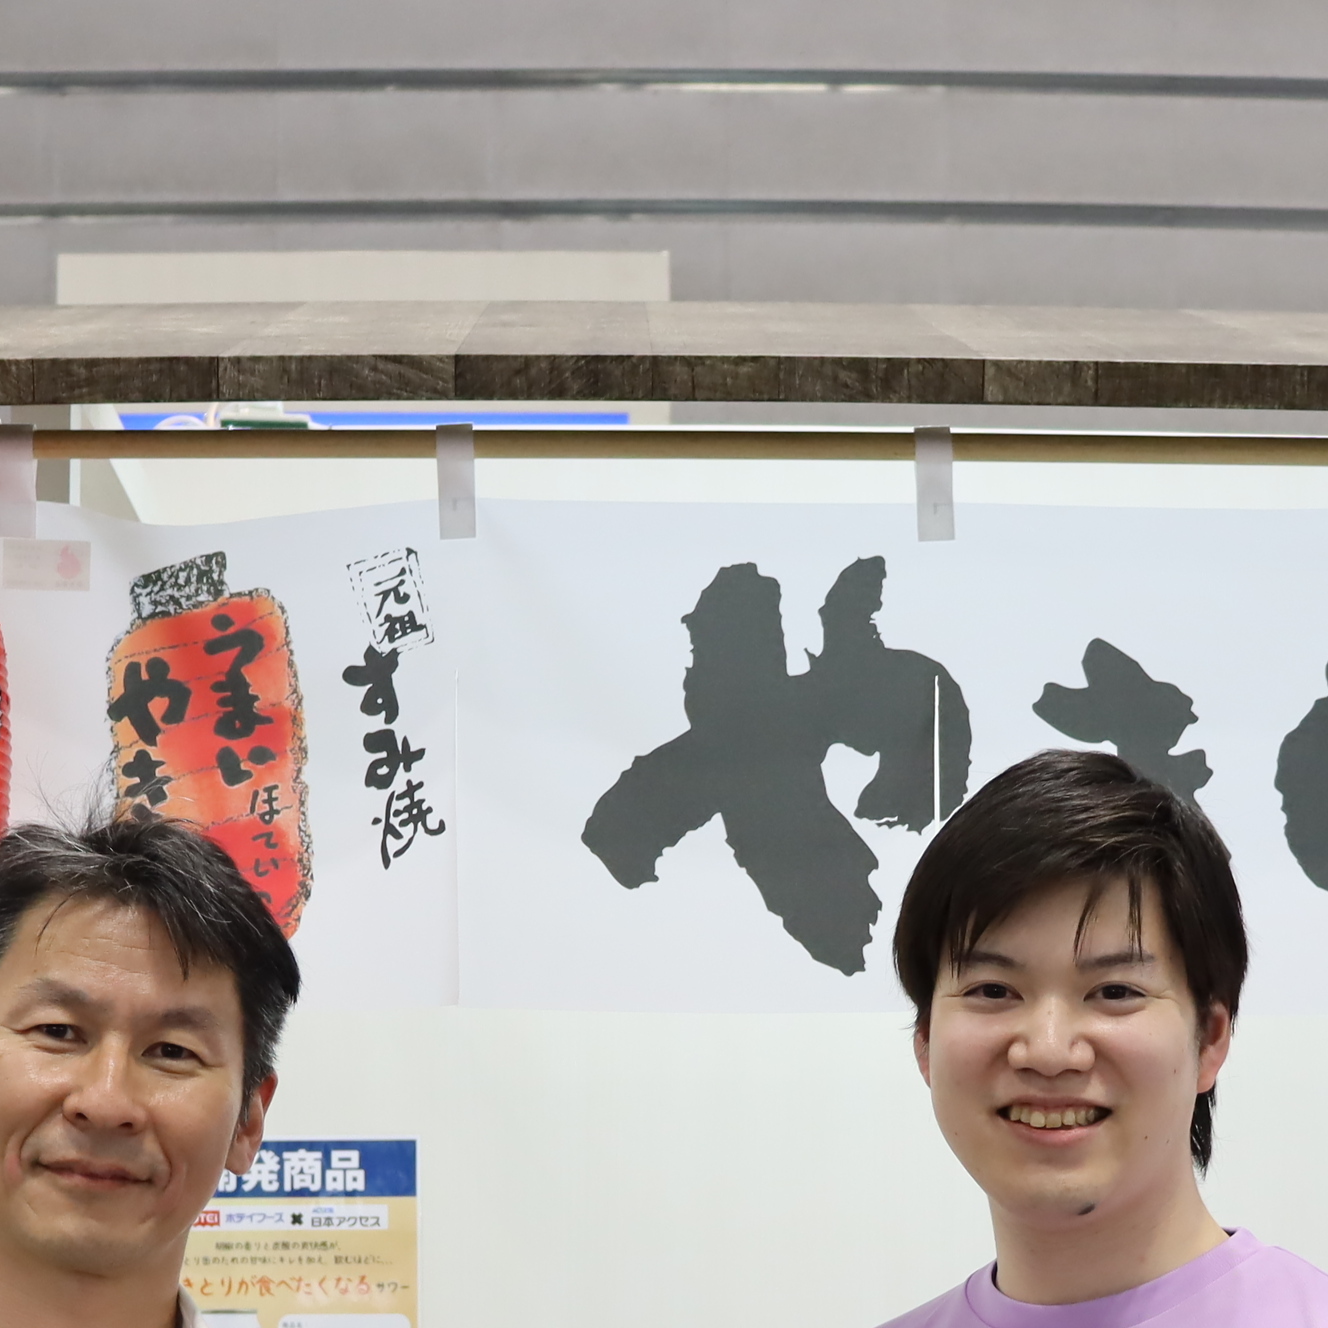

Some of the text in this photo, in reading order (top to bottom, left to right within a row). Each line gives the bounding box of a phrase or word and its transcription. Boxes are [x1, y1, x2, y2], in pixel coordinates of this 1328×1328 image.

[374, 566, 424, 644] 元祖
[107, 656, 191, 822] やき
[204, 613, 278, 786] うまい
[342, 644, 446, 870] すみ焼
[225, 1212, 382, 1228] ホテイフーズ 日本アクセス
[375, 1283, 410, 1292] サワー
